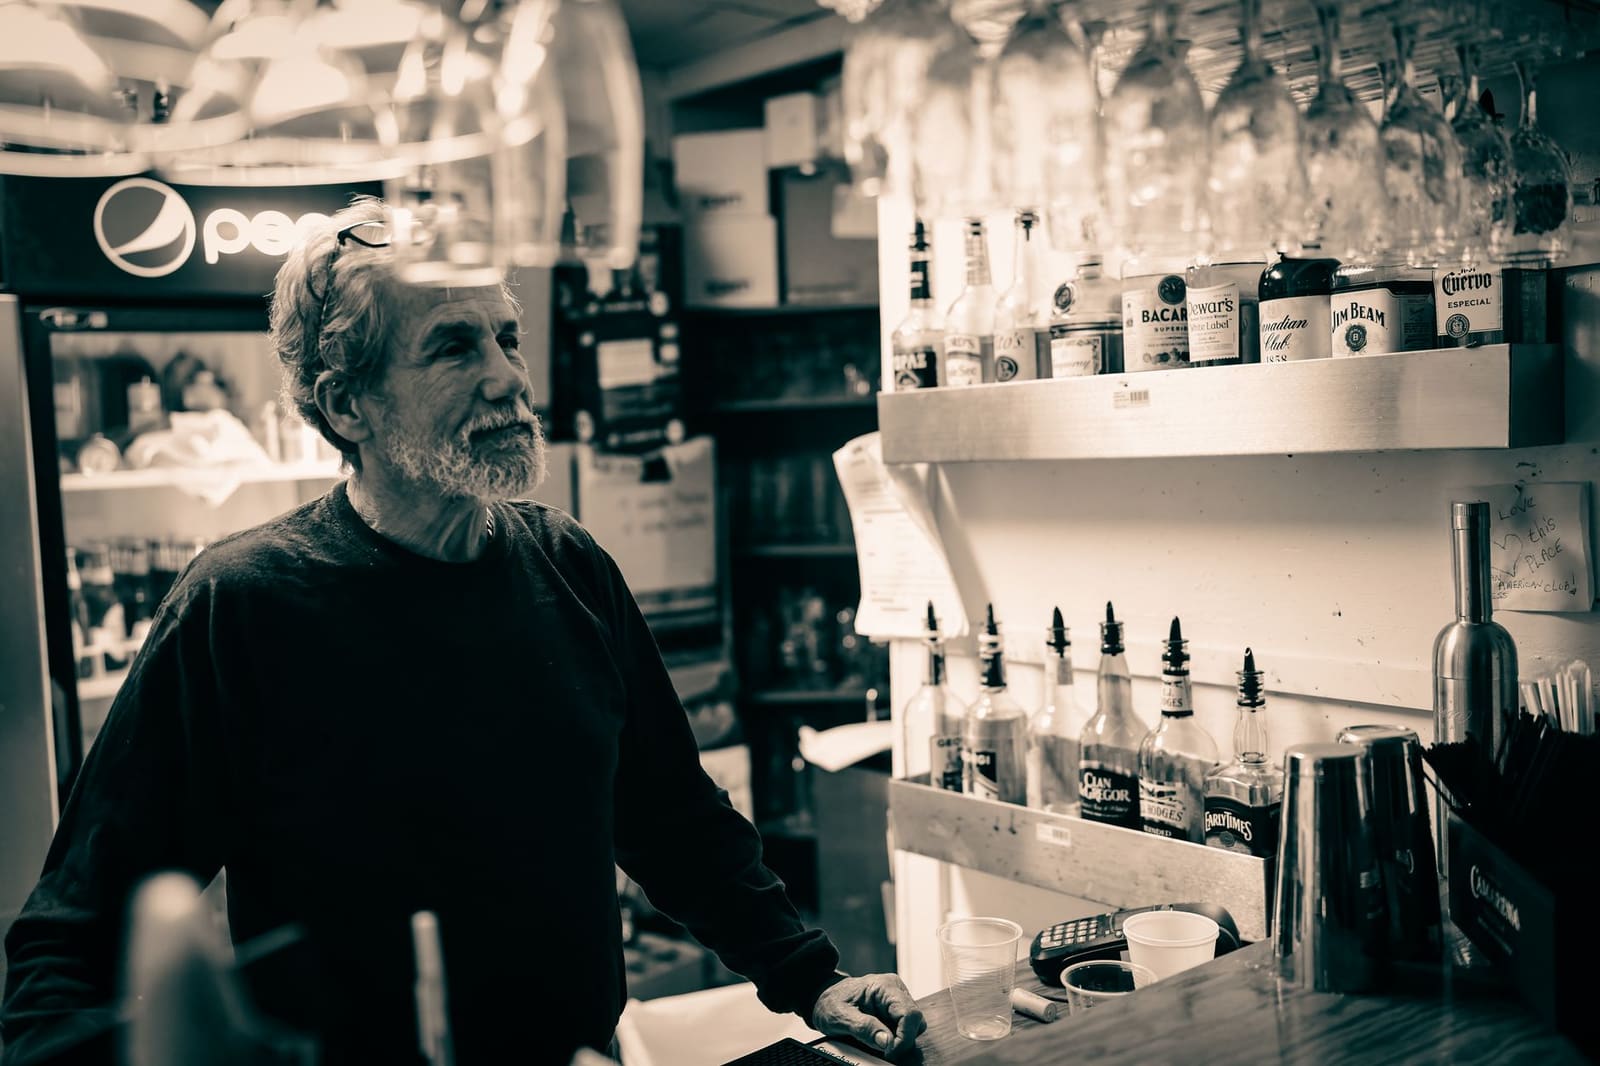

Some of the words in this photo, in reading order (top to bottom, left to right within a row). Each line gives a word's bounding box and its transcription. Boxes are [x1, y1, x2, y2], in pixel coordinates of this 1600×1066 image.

[1442, 271, 1492, 296] Cuervo
[1141, 307, 1188, 323] BACAR
[1447, 298, 1491, 309] ESPECIAL
[1261, 314, 1309, 333] nadian
[1331, 307, 1348, 334] JIM
[1350, 302, 1385, 327] BEAM
[1498, 497, 1537, 521] LOVE
[1527, 516, 1557, 543] this
[1524, 537, 1563, 574] PLACE
